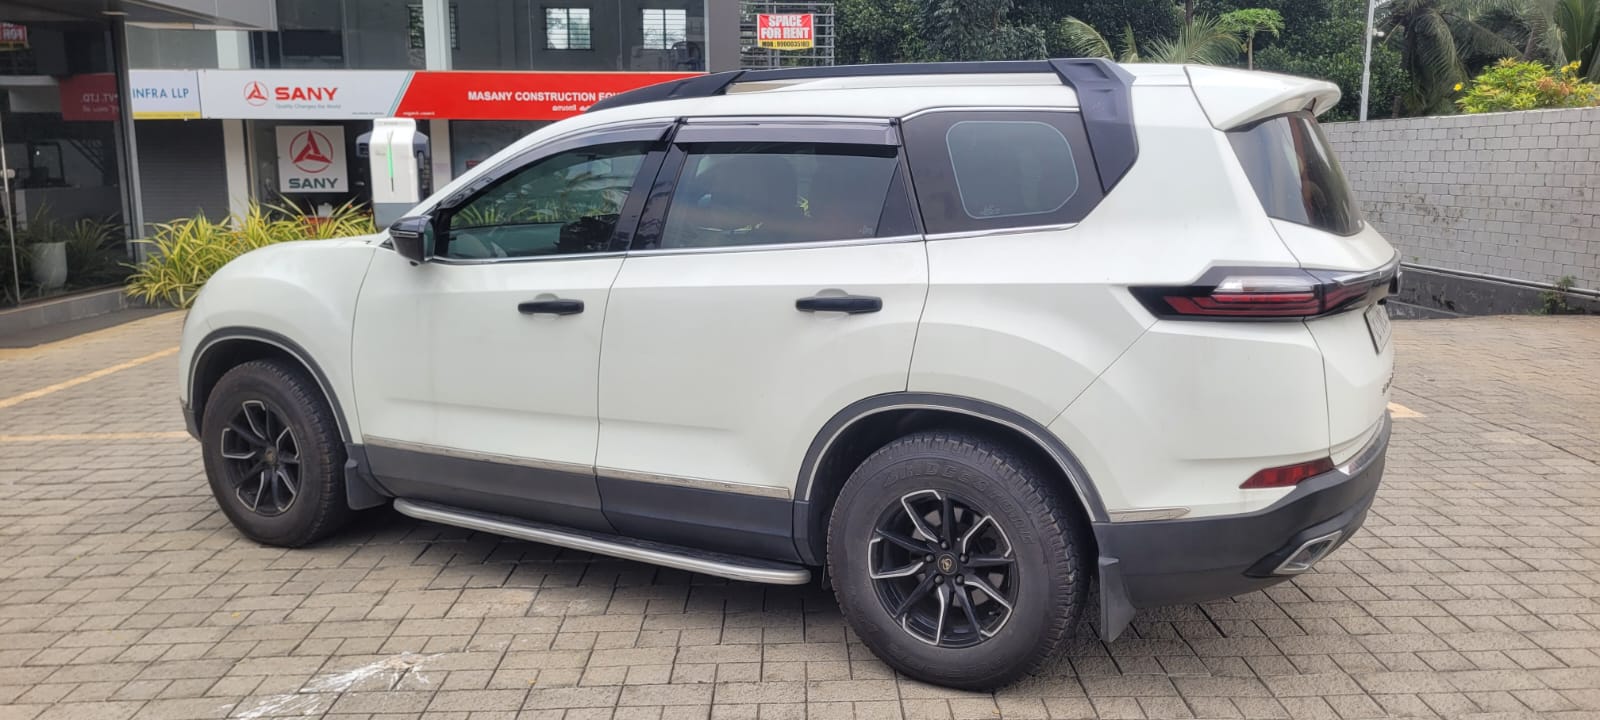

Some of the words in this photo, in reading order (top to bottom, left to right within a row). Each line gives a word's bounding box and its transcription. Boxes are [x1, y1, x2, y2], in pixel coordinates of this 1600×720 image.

[768, 15, 802, 26] SPACE
[761, 27, 781, 39] FOR
[783, 27, 810, 39] RENT
[132, 88, 168, 99] INFRA
[171, 88, 189, 99] LLP
[275, 87, 338, 101] SANY
[468, 91, 512, 101] MASANY
[514, 91, 596, 102] CONSTRUCTION
[288, 177, 338, 189] SANY
